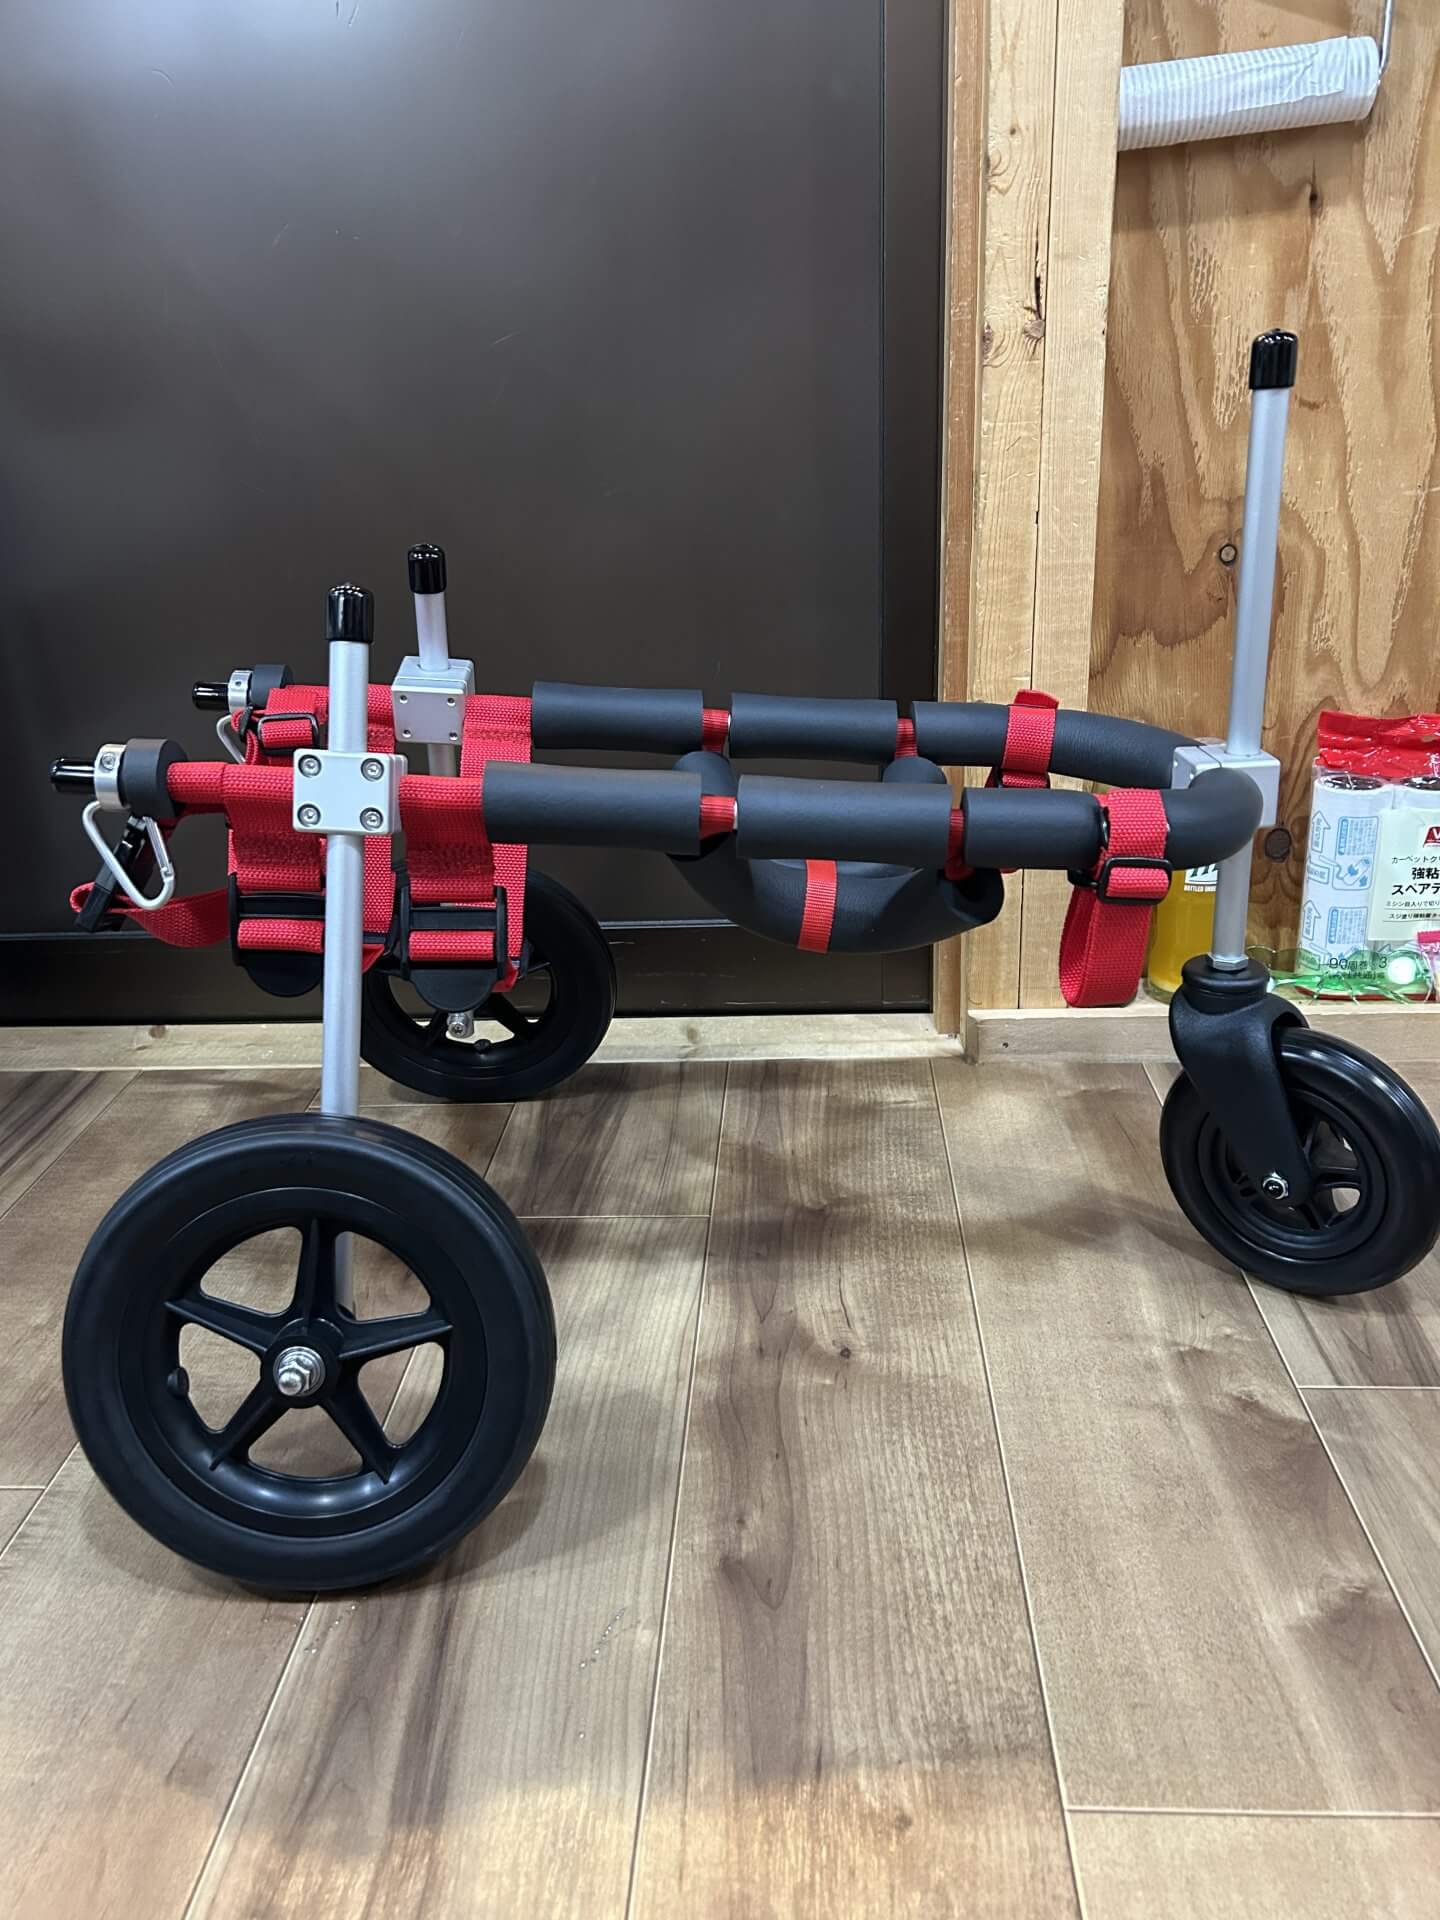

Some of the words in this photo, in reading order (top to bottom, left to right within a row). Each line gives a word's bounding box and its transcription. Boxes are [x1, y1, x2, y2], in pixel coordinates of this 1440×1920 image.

[1391, 855, 1440, 865] カーペットク
[1411, 867, 1440, 880] 強粘
